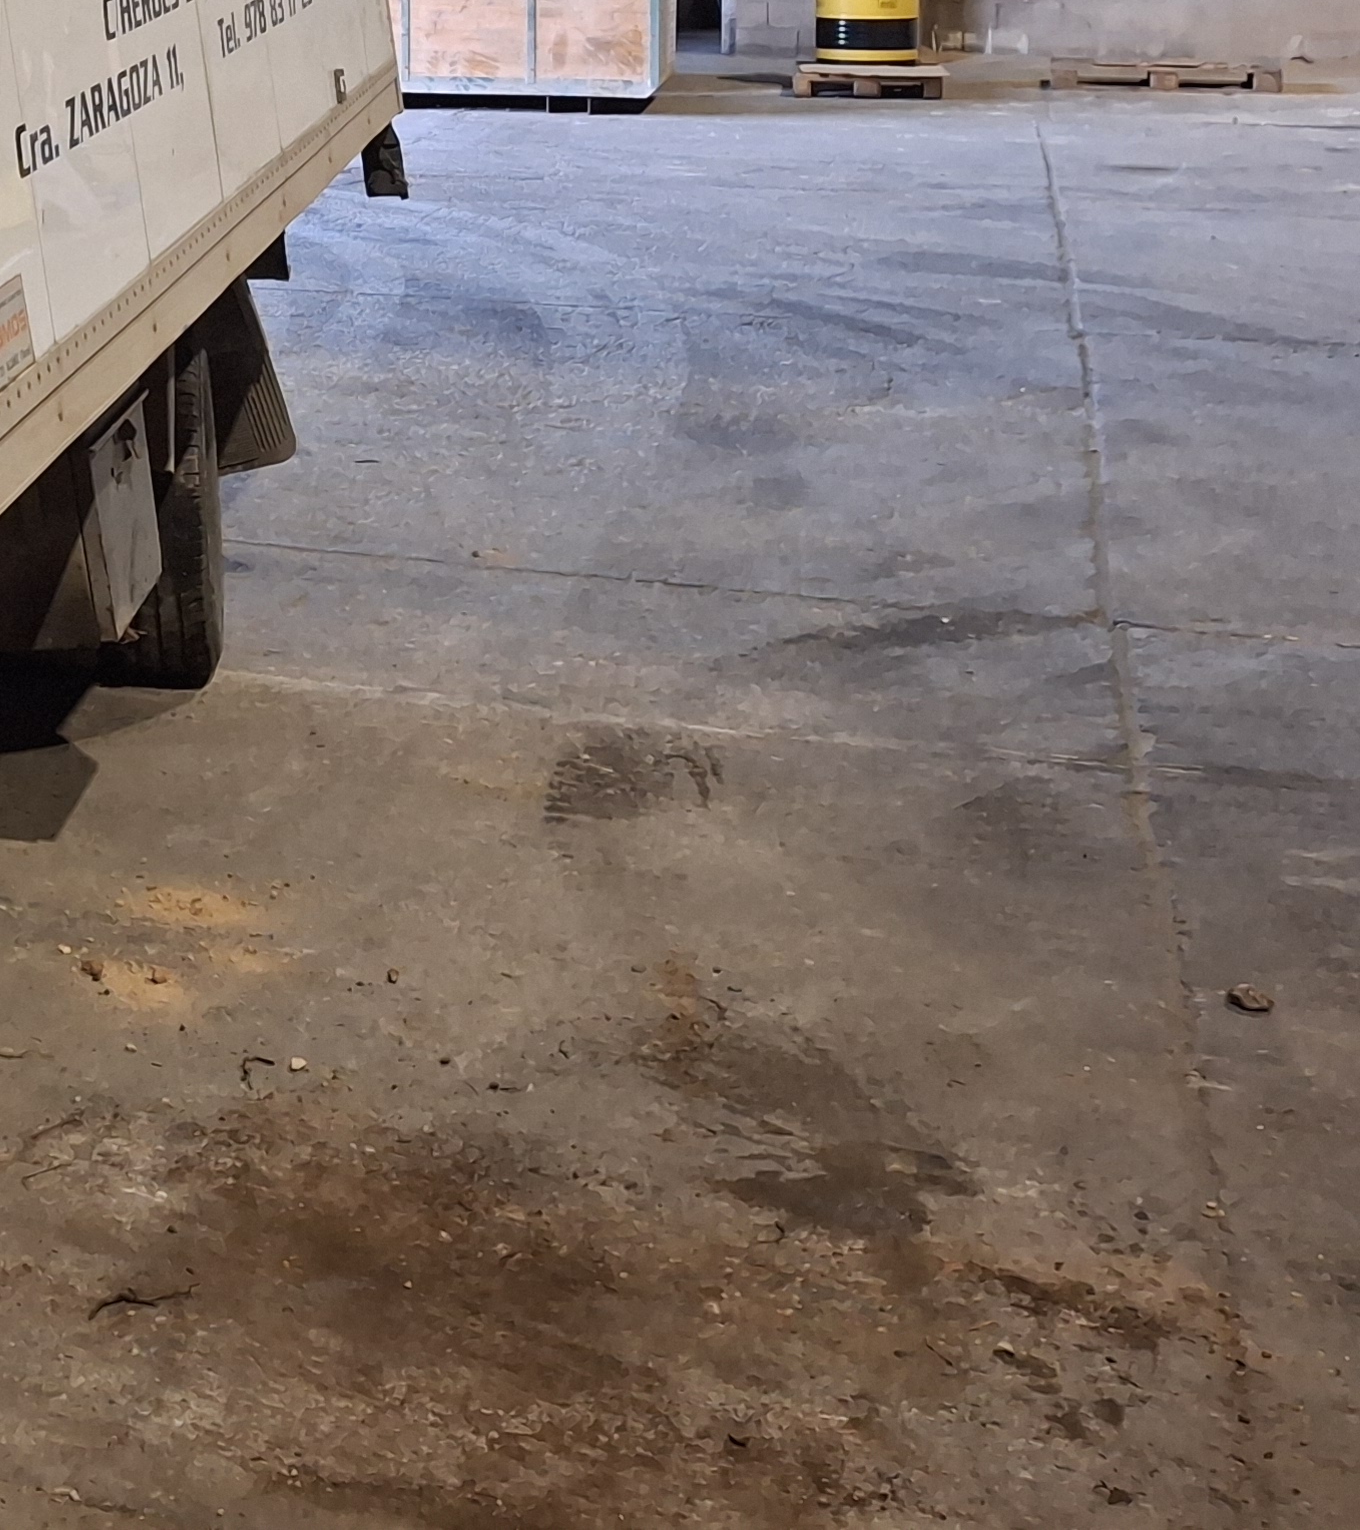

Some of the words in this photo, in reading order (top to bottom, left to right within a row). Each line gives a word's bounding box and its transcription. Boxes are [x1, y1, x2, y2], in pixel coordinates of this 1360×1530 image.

[14, 122, 60, 179] Cra.
[64, 53, 163, 150] ZARAGOZA
[166, 43, 185, 93] 11,
[217, 11, 241, 58] Tel.
